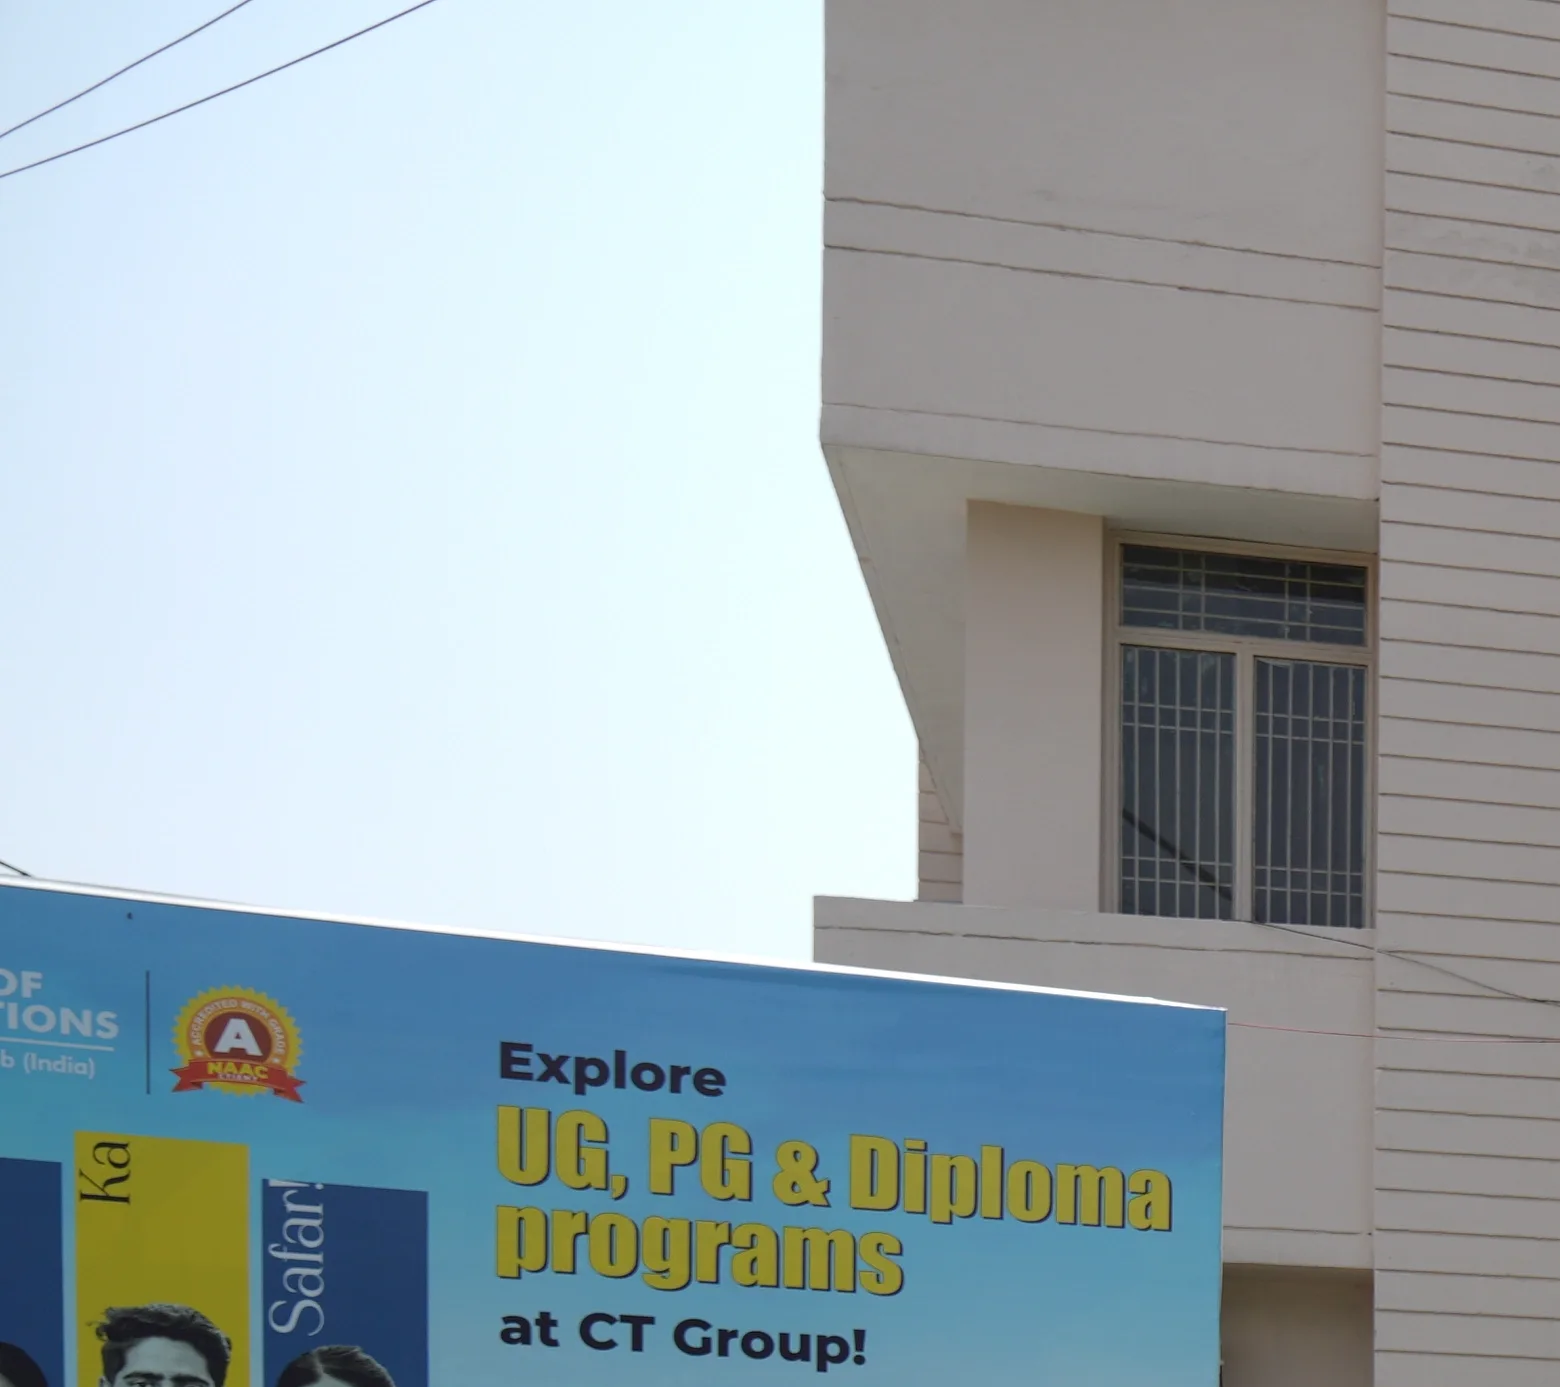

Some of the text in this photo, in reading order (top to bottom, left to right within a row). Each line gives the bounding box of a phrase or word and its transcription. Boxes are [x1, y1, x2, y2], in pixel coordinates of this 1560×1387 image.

[0, 1001, 119, 1039] IONS
[213, 1018, 263, 1056] A
[24, 1051, 96, 1080] (India)
[207, 1061, 269, 1080] NAAC
[499, 1042, 727, 1097] Explore
[496, 1105, 1172, 1232] UG, PG & Diploma
[268, 1179, 325, 1336] Safar!
[496, 1205, 904, 1297] programs
[500, 1313, 867, 1374] at CT Group!
